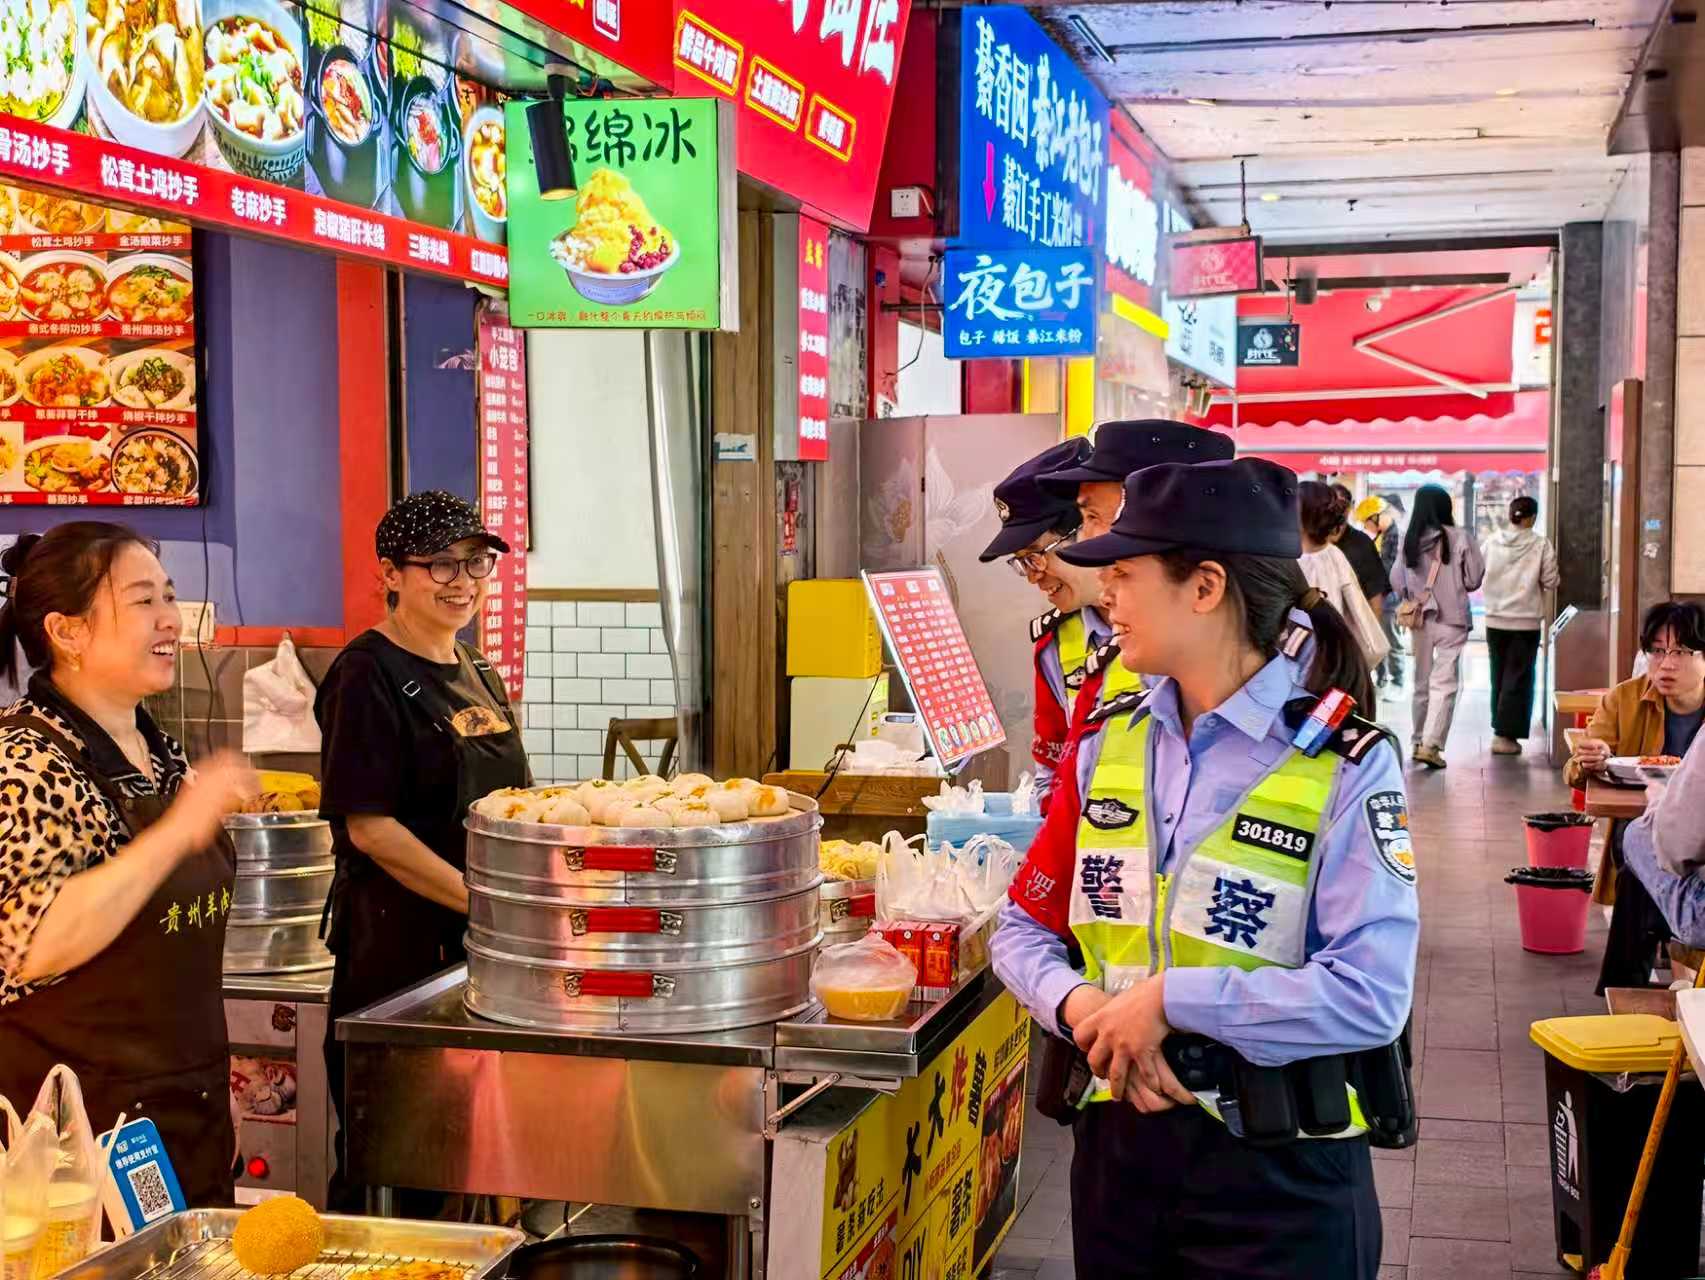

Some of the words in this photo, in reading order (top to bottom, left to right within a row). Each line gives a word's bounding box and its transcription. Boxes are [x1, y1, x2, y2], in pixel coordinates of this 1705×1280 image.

[101, 154, 199, 205] 松茸土鸡抄手
[230, 186, 287, 225] 老麻抄手
[31, 236, 95, 248] 松茸土鸡抄手
[948, 254, 1094, 321] 夜包子
[959, 329, 987, 346] 包子
[1236, 820, 1308, 853] 301819
[1080, 854, 1125, 920] 警
[1203, 876, 1276, 949] 察
